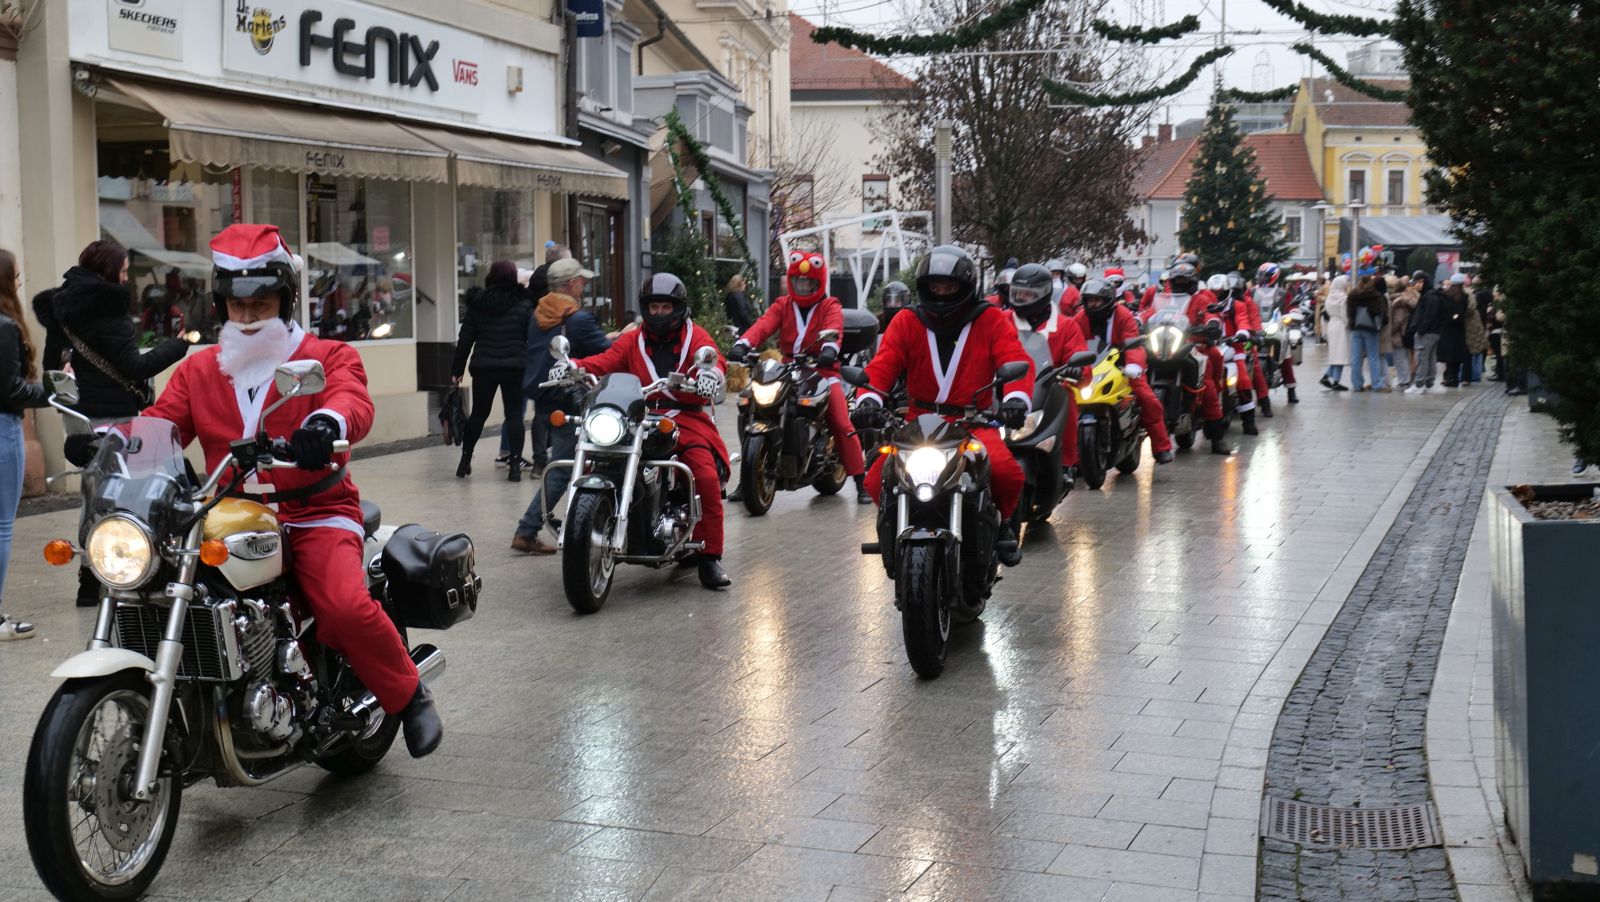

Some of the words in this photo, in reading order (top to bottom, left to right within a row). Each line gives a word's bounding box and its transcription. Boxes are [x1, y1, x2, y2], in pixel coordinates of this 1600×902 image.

[119, 8, 177, 29] SKECHERS
[236, 14, 287, 35] Martens
[299, 9, 440, 92] FENIX
[452, 58, 479, 86] VANS
[305, 151, 346, 170] FENIX
